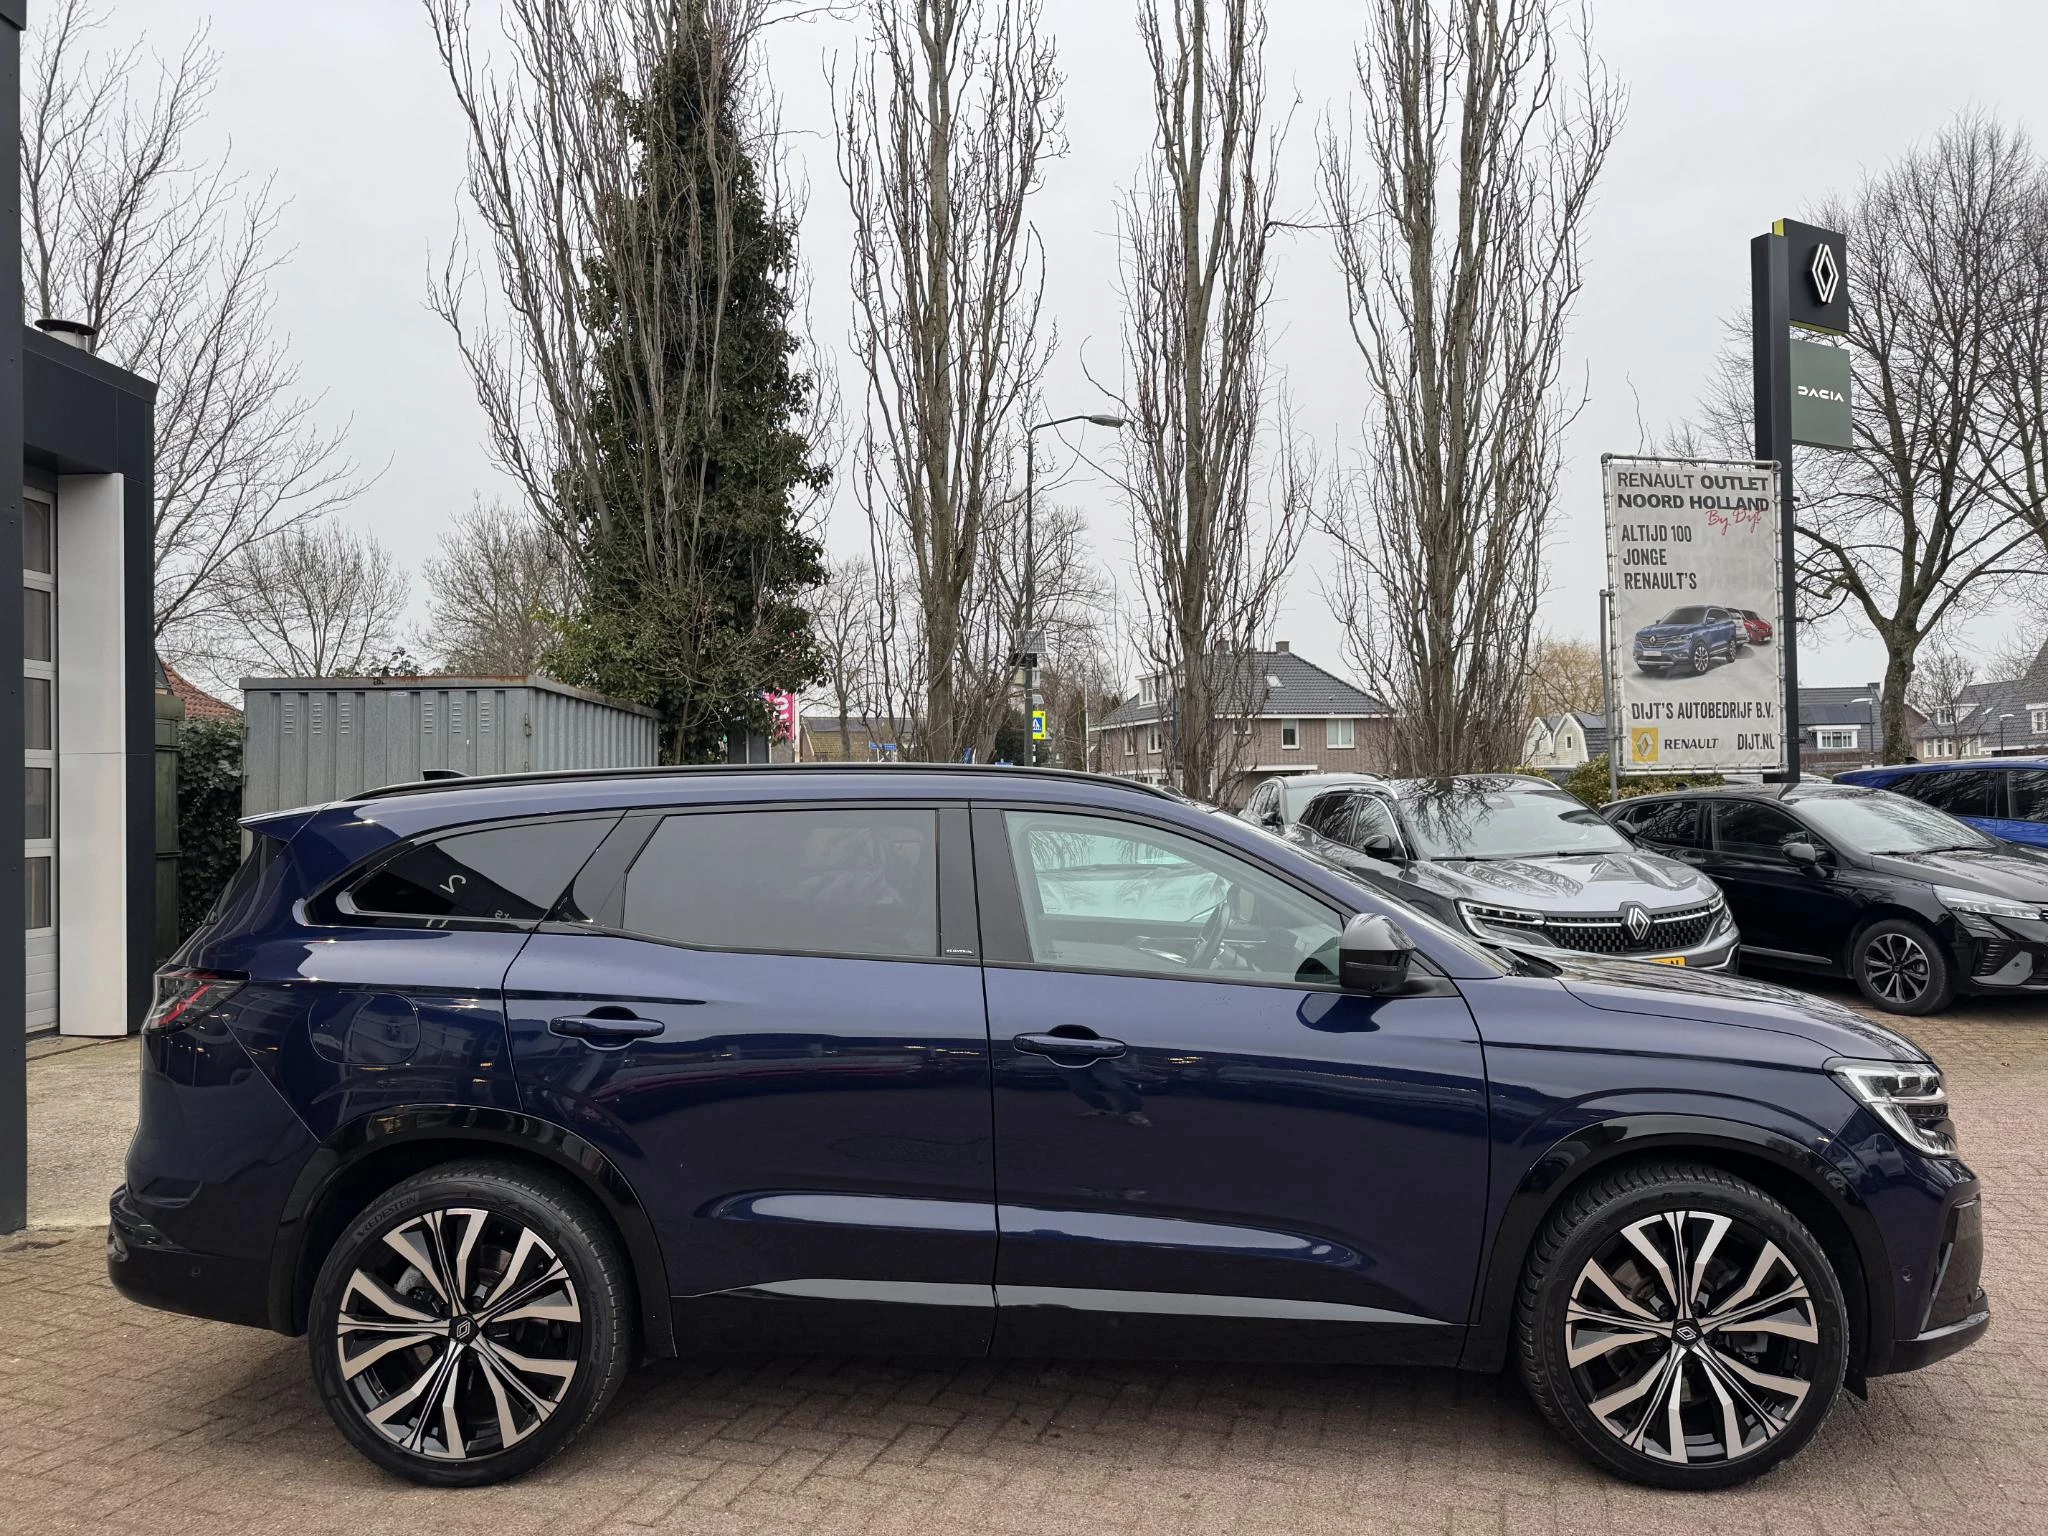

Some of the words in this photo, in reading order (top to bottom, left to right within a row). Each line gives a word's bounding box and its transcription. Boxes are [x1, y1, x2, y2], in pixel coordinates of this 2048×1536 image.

[1797, 385, 1845, 402] DACIA
[1617, 472, 1695, 489] RENAULT
[1700, 475, 1769, 491] OUTLET
[1617, 493, 1685, 508] NOORD
[1689, 495, 1770, 511] HOLLAND
[1705, 509, 1730, 536] By
[1621, 524, 1668, 542] ALTIJD
[1671, 525, 1692, 543] 100
[1622, 548, 1667, 566] JONGE
[1623, 572, 1697, 590] RENAULT'S
[1631, 702, 1673, 720] DIJT'S
[1677, 702, 1753, 719] AUTOBEDRIJF
[1756, 702, 1774, 719] B.V.
[1664, 738, 1719, 750] RENAULT
[1737, 733, 1775, 751] DIJT.NL
